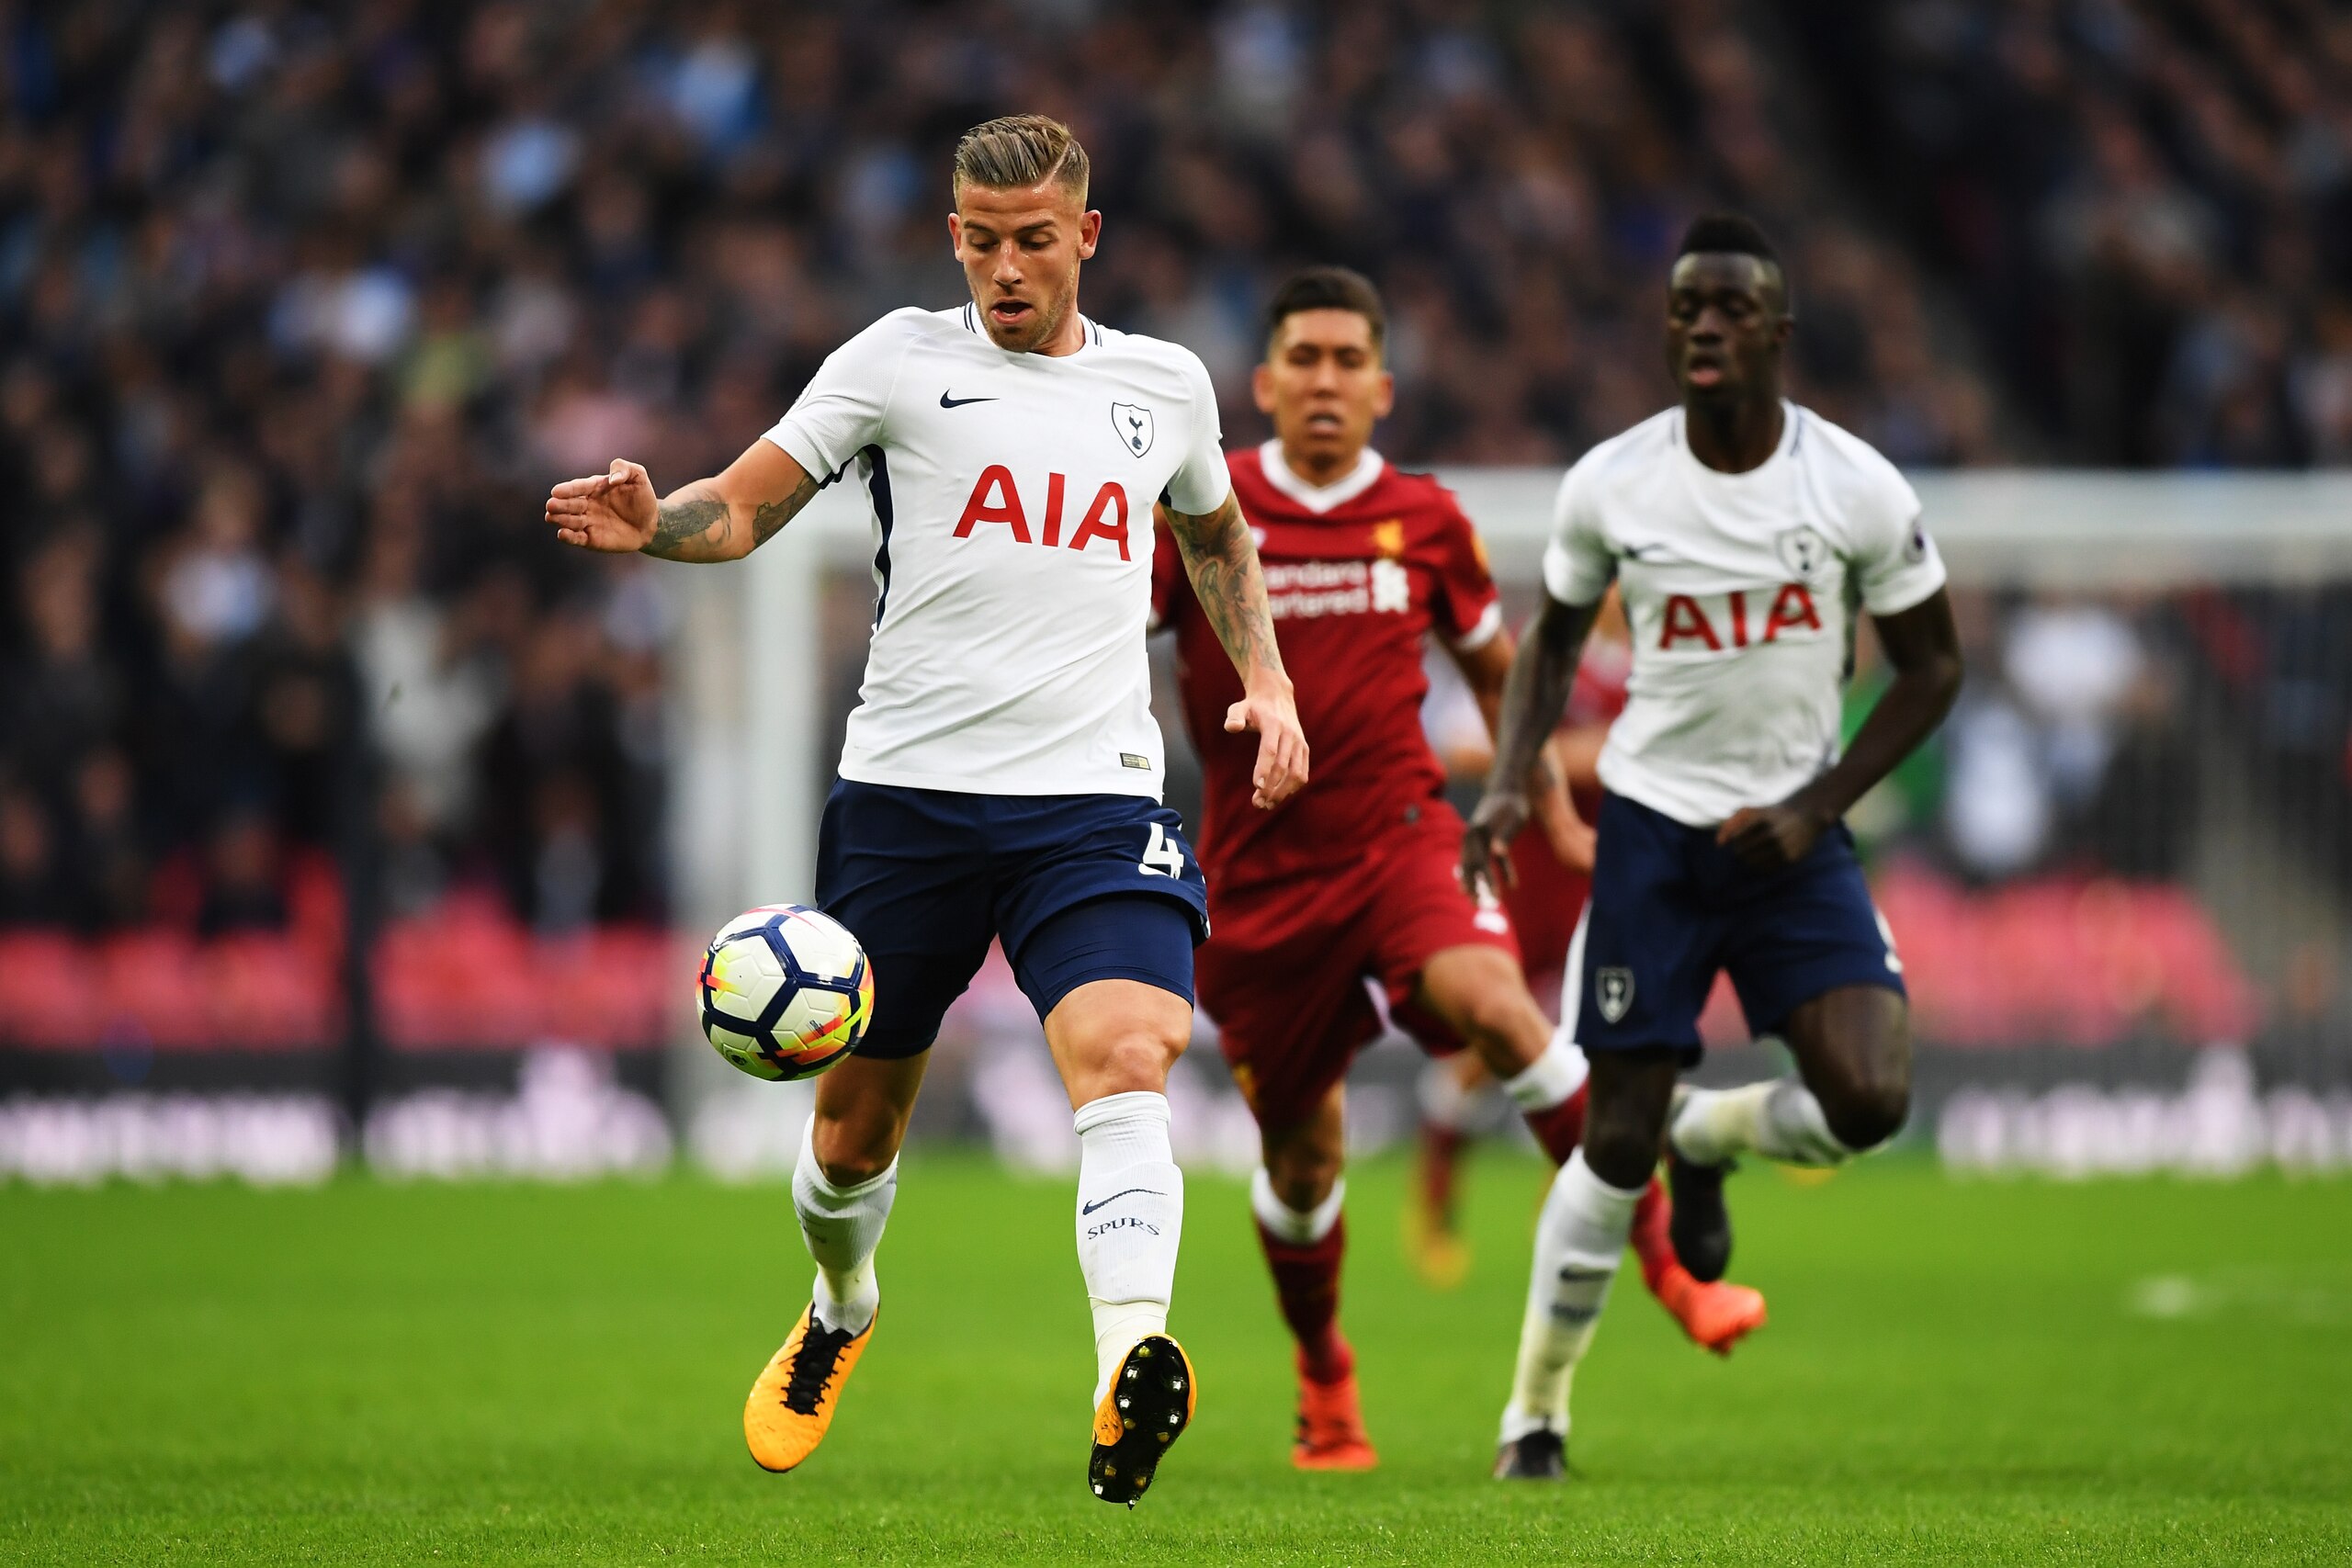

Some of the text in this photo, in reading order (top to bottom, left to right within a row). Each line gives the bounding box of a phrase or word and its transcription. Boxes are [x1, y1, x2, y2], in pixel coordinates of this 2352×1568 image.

[952, 464, 1131, 562] AIA
[1269, 586, 1369, 619] artered
[1657, 583, 1822, 650] AIA
[1142, 821, 1184, 880] 4
[1088, 1217, 1160, 1240] SPURS
